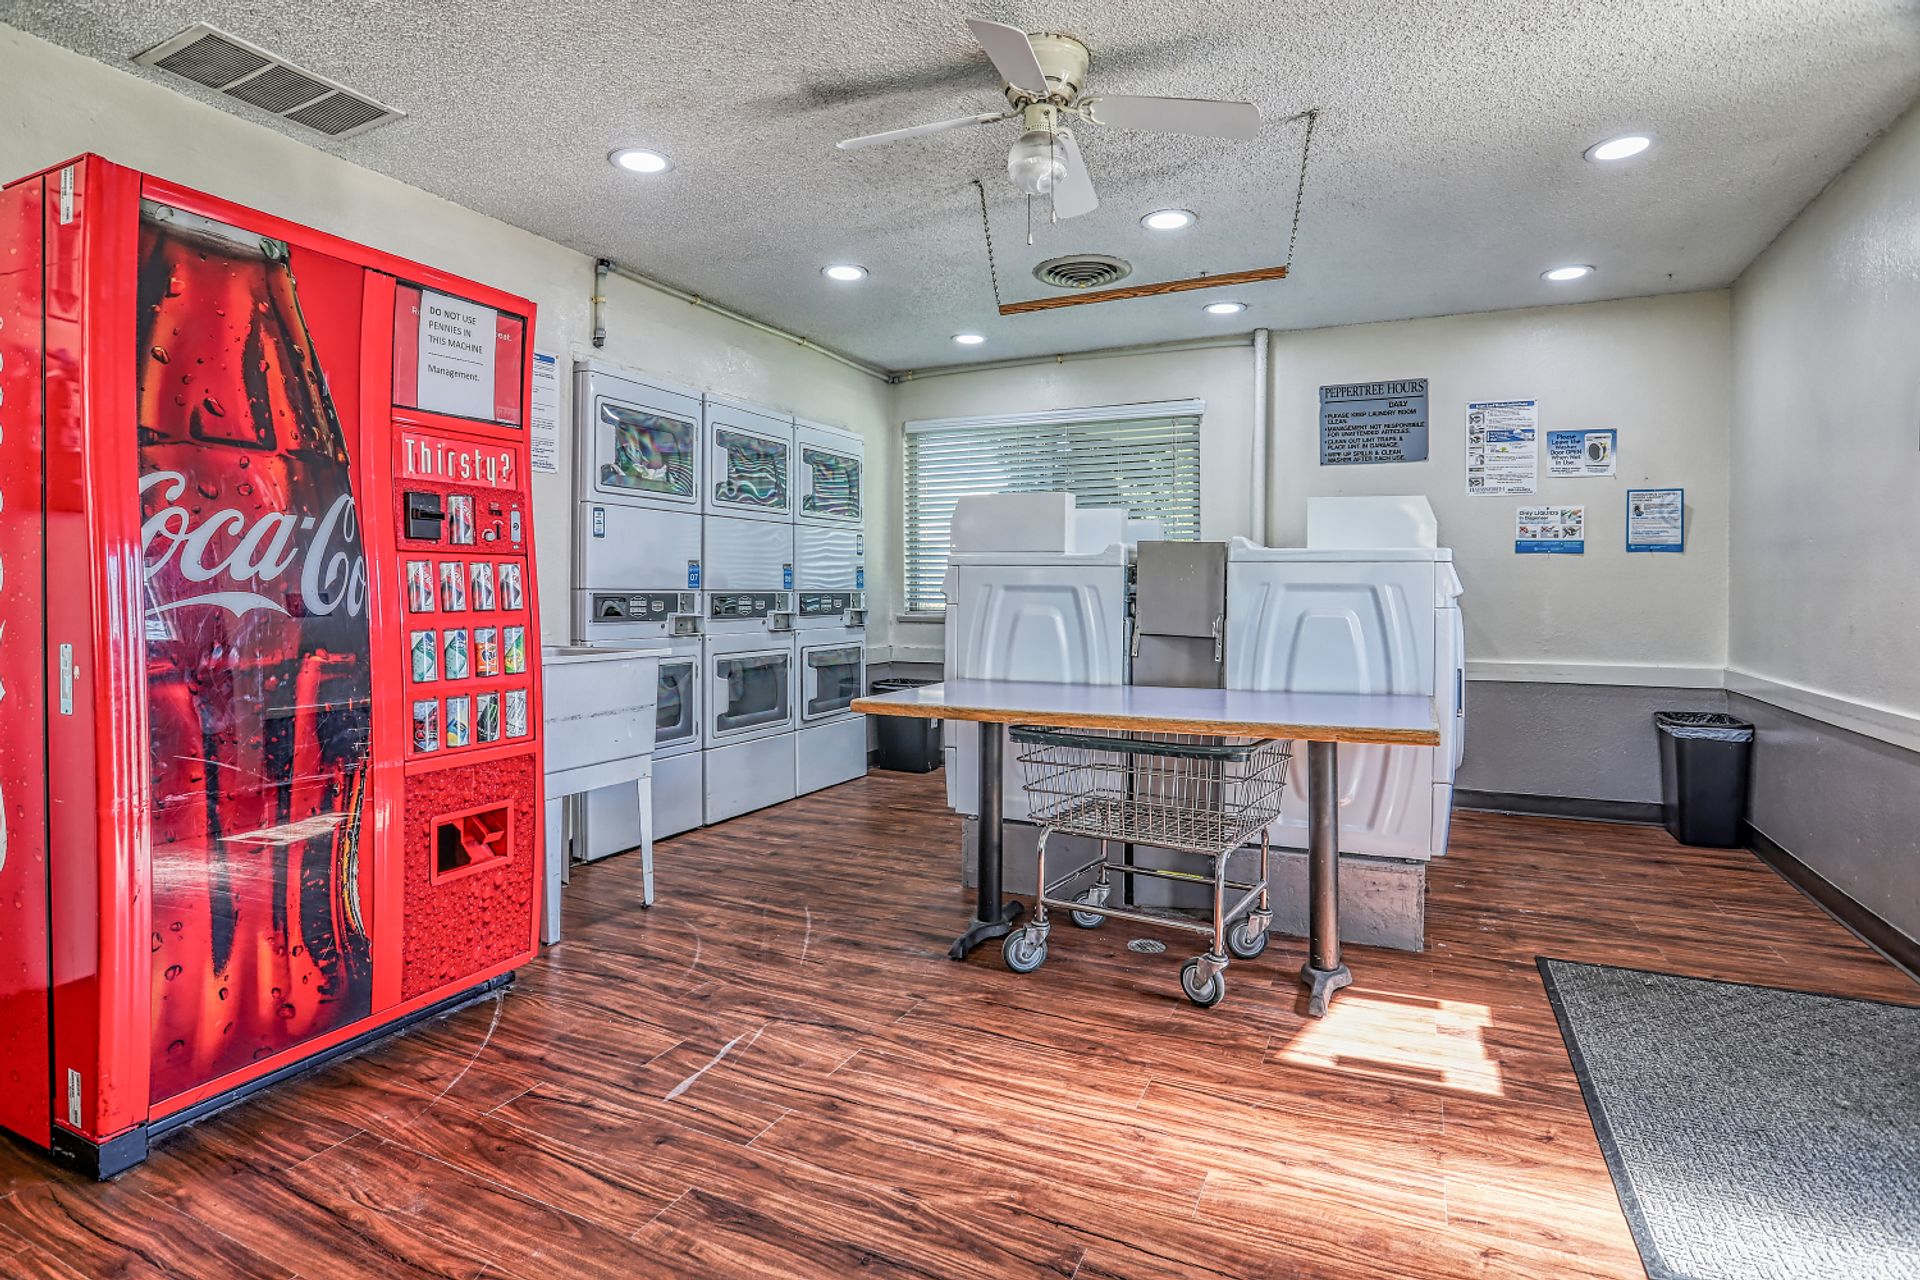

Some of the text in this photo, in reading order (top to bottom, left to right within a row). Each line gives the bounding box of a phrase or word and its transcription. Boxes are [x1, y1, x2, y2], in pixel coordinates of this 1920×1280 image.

[430, 306, 441, 316] DO
[444, 310, 460, 321] NOT
[462, 315, 476, 325] USE
[428, 320, 471, 338] PENNIES IN
[428, 334, 483, 355] THIS MACHINE
[427, 364, 480, 382] Management.
[1325, 381, 1424, 399] PEPPERTREE HOURS
[1368, 409, 1396, 417] LAUNDRY
[1327, 424, 1367, 432] MANAGEMENT
[1384, 421, 1425, 429] RESPONSIBLE
[1341, 429, 1379, 437] UNATTENDED
[405, 439, 510, 488] Thirsty?
[690, 573, 698, 581] 07
